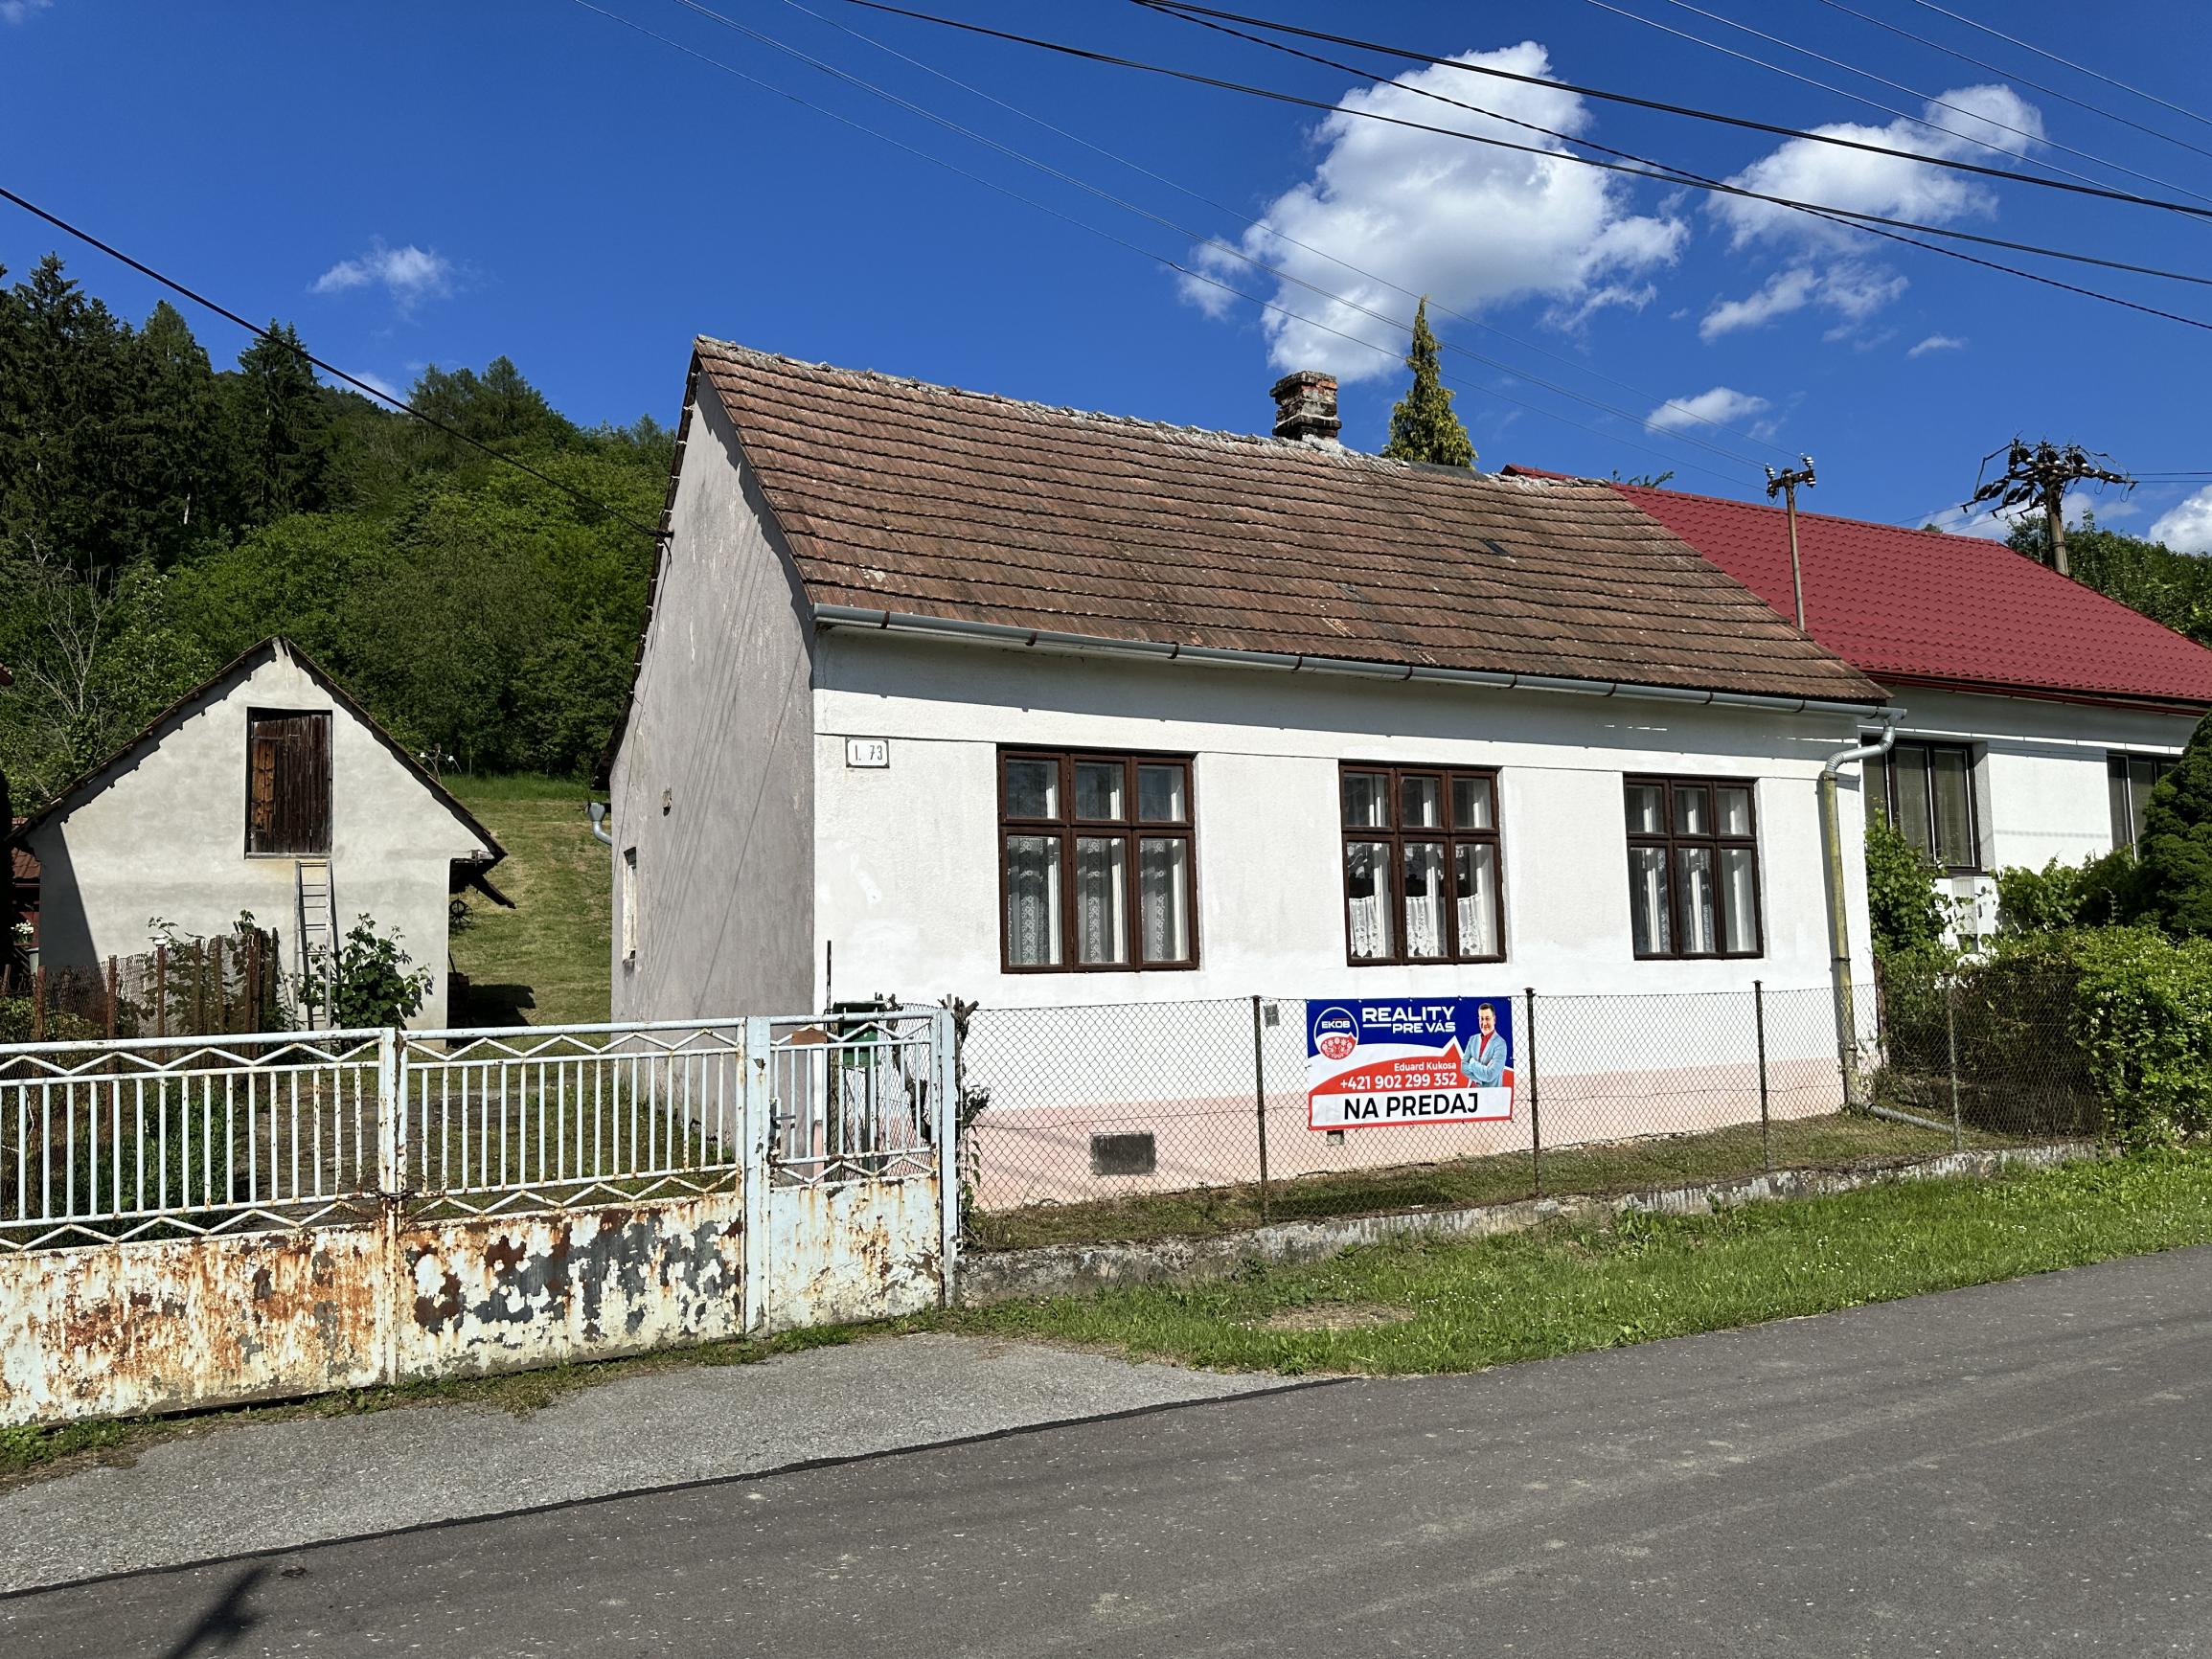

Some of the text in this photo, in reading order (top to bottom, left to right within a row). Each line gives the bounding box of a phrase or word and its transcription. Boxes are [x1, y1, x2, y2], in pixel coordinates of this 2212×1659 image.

[870, 745, 882, 761] 73
[1362, 1006, 1455, 1022] REALITY
[1393, 1021, 1456, 1034] PRE VÁS
[1394, 1061, 1456, 1072] Eduard Kukosa
[1340, 1072, 1457, 1090] +421 902 299 352
[1344, 1093, 1478, 1120] NA PREDAJ
